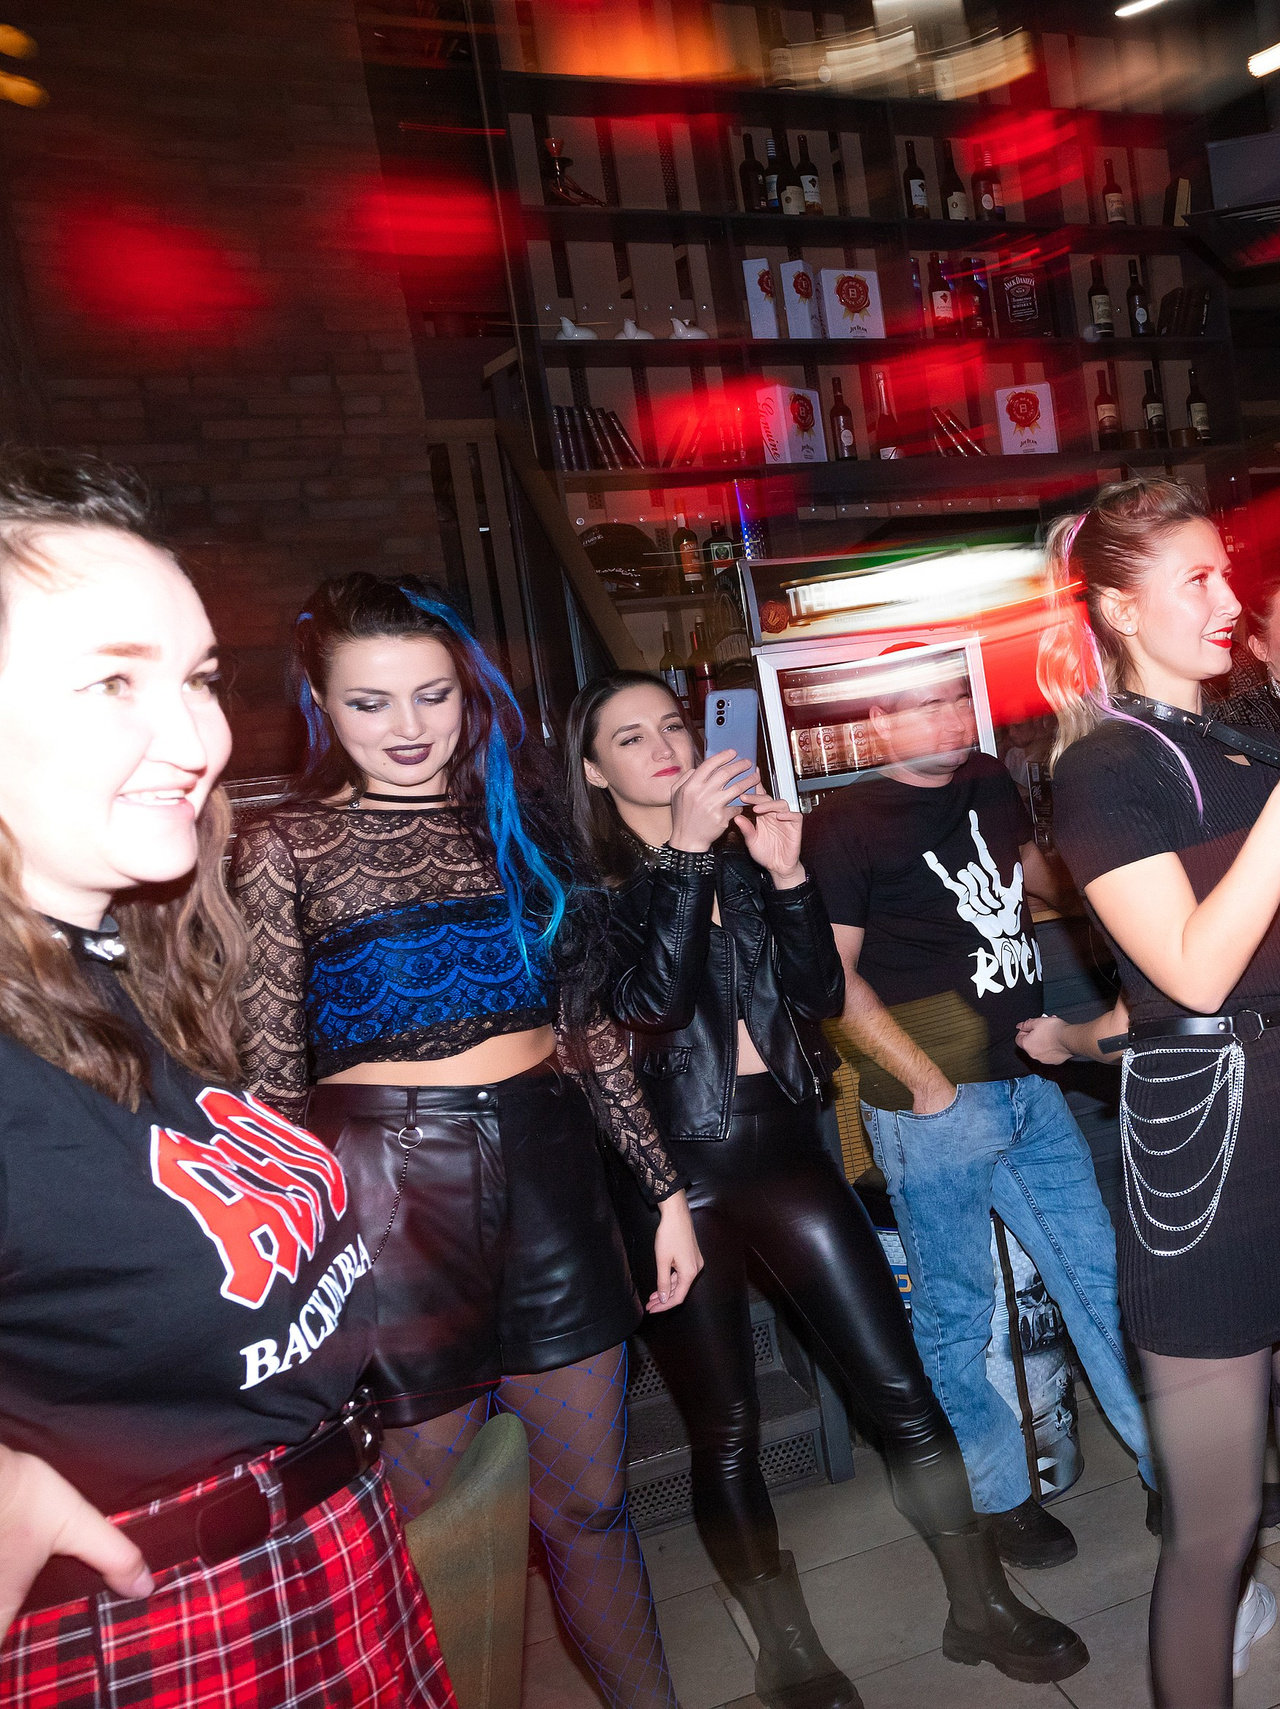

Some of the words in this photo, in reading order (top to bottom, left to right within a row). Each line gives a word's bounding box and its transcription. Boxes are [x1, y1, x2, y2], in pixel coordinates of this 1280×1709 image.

[848, 287, 857, 298] B
[1004, 280, 1016, 291] JACK
[758, 397, 781, 462] Genuine
[239, 1288, 338, 1390] BACK
[317, 1273, 346, 1319] IN
